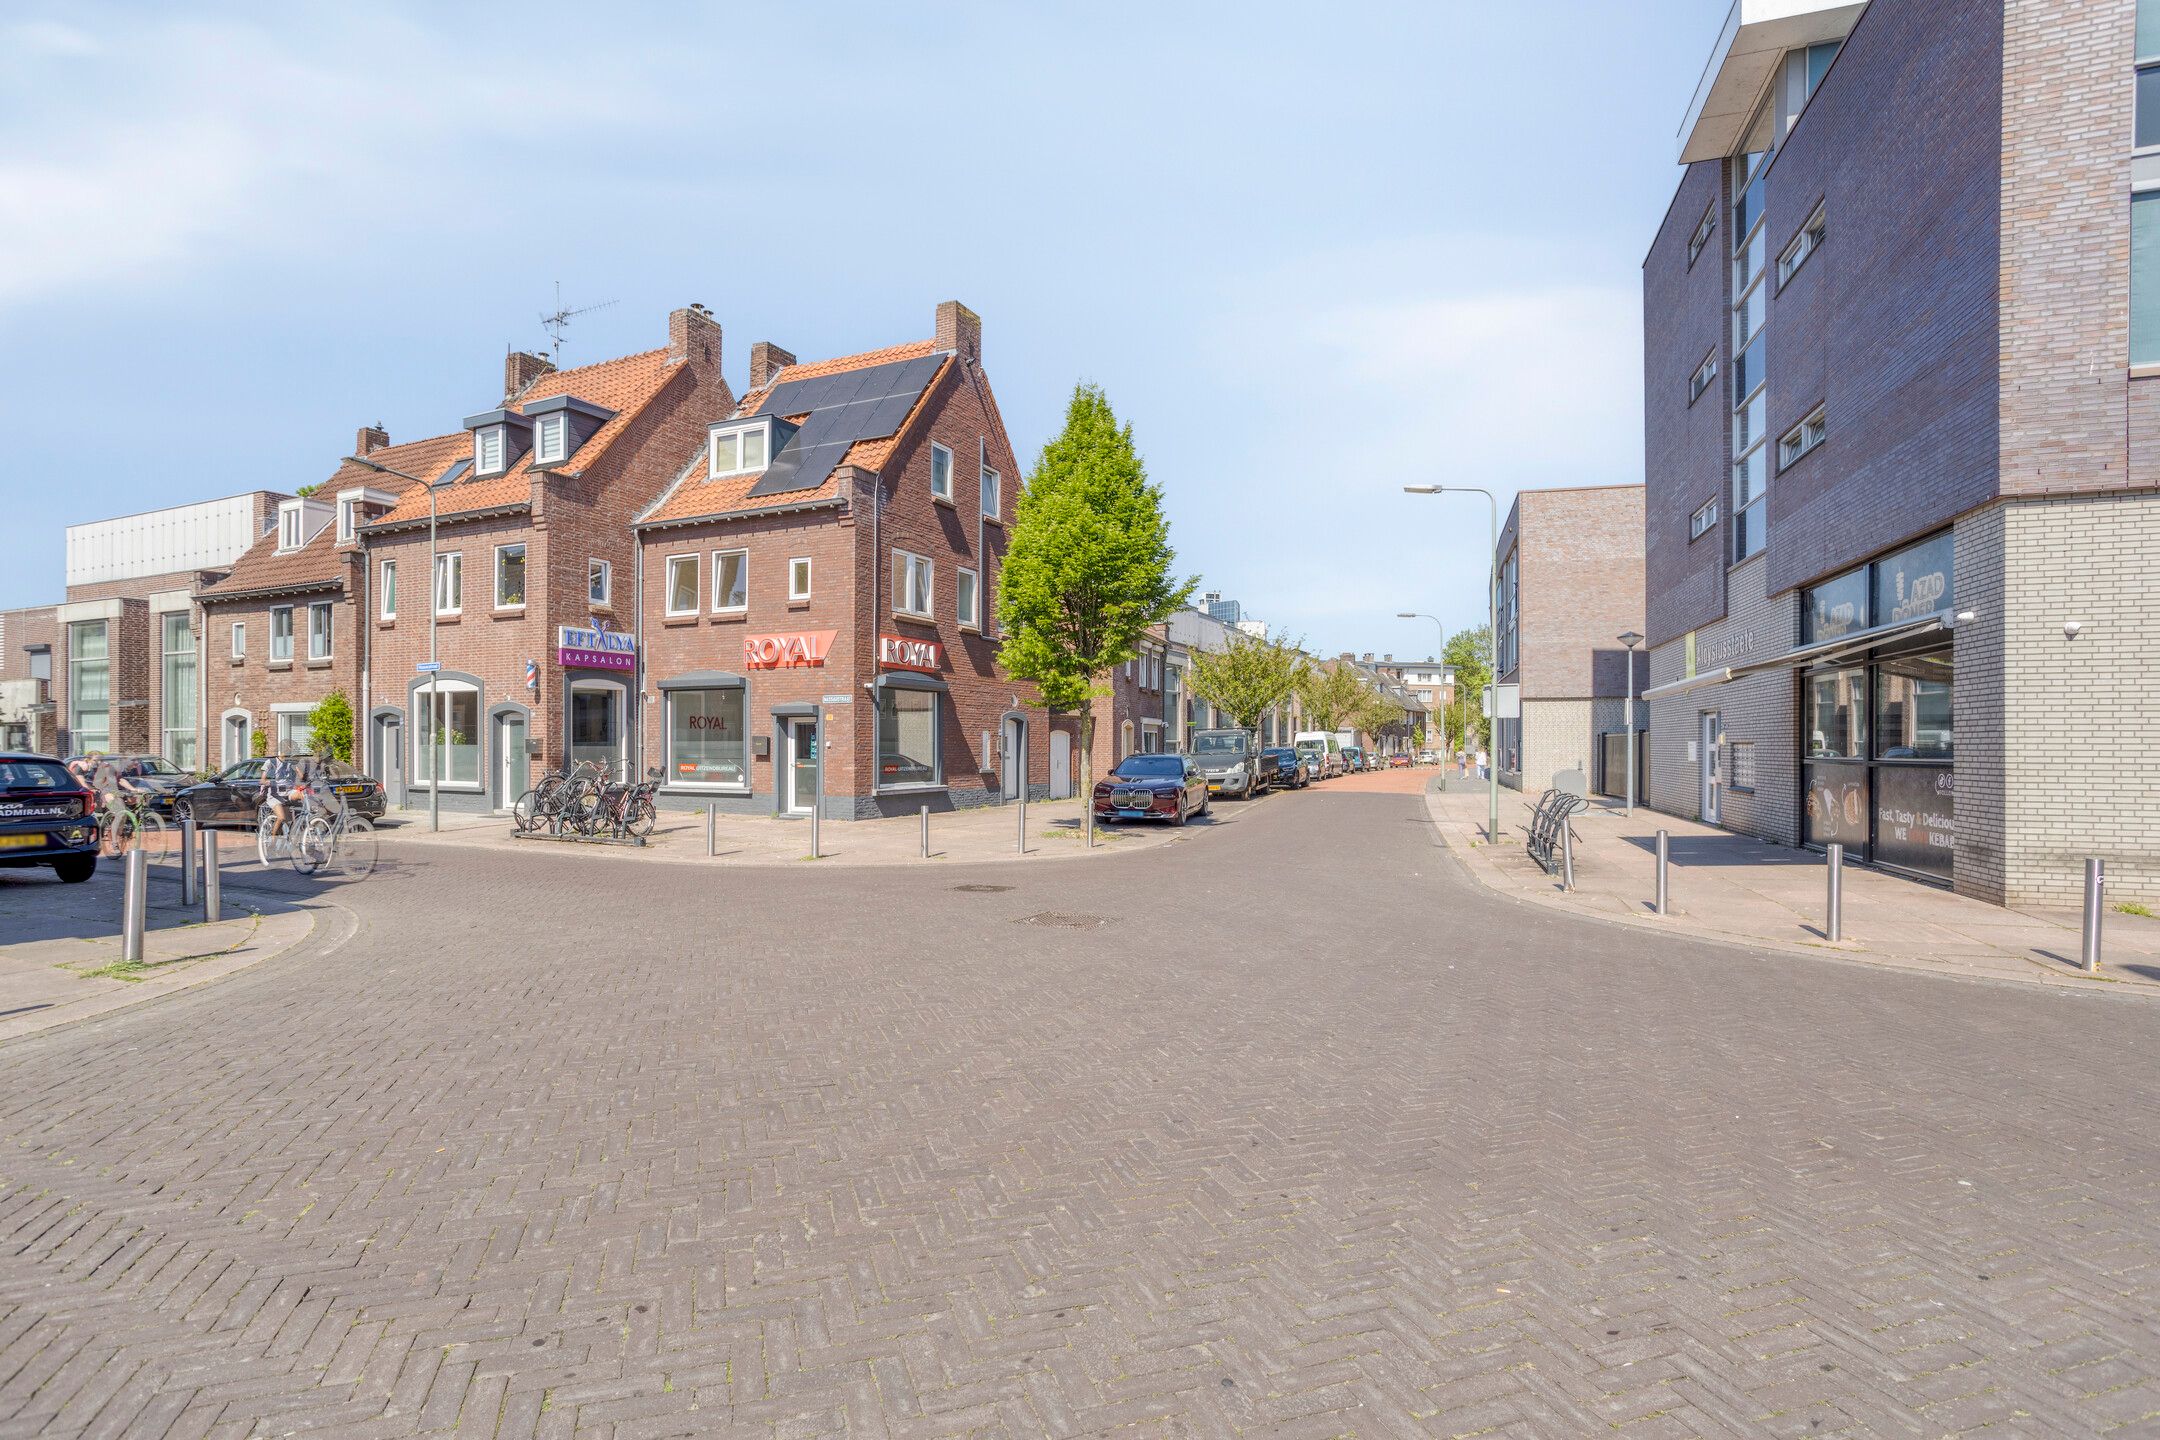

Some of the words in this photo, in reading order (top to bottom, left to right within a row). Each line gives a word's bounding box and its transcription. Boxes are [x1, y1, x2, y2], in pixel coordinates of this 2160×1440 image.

[1911, 572, 1944, 601] AZAD
[563, 620, 634, 652] EFTALYA
[565, 653, 631, 666] KAPSALON
[744, 635, 826, 664] ROYAL
[881, 637, 941, 669] ROYAL
[689, 716, 727, 730] ROYAL
[1879, 808, 1894, 822] Fast,
[1895, 809, 1915, 828] Tasty
[1923, 812, 1954, 830] Deliciou
[1895, 827, 1907, 840] WE
